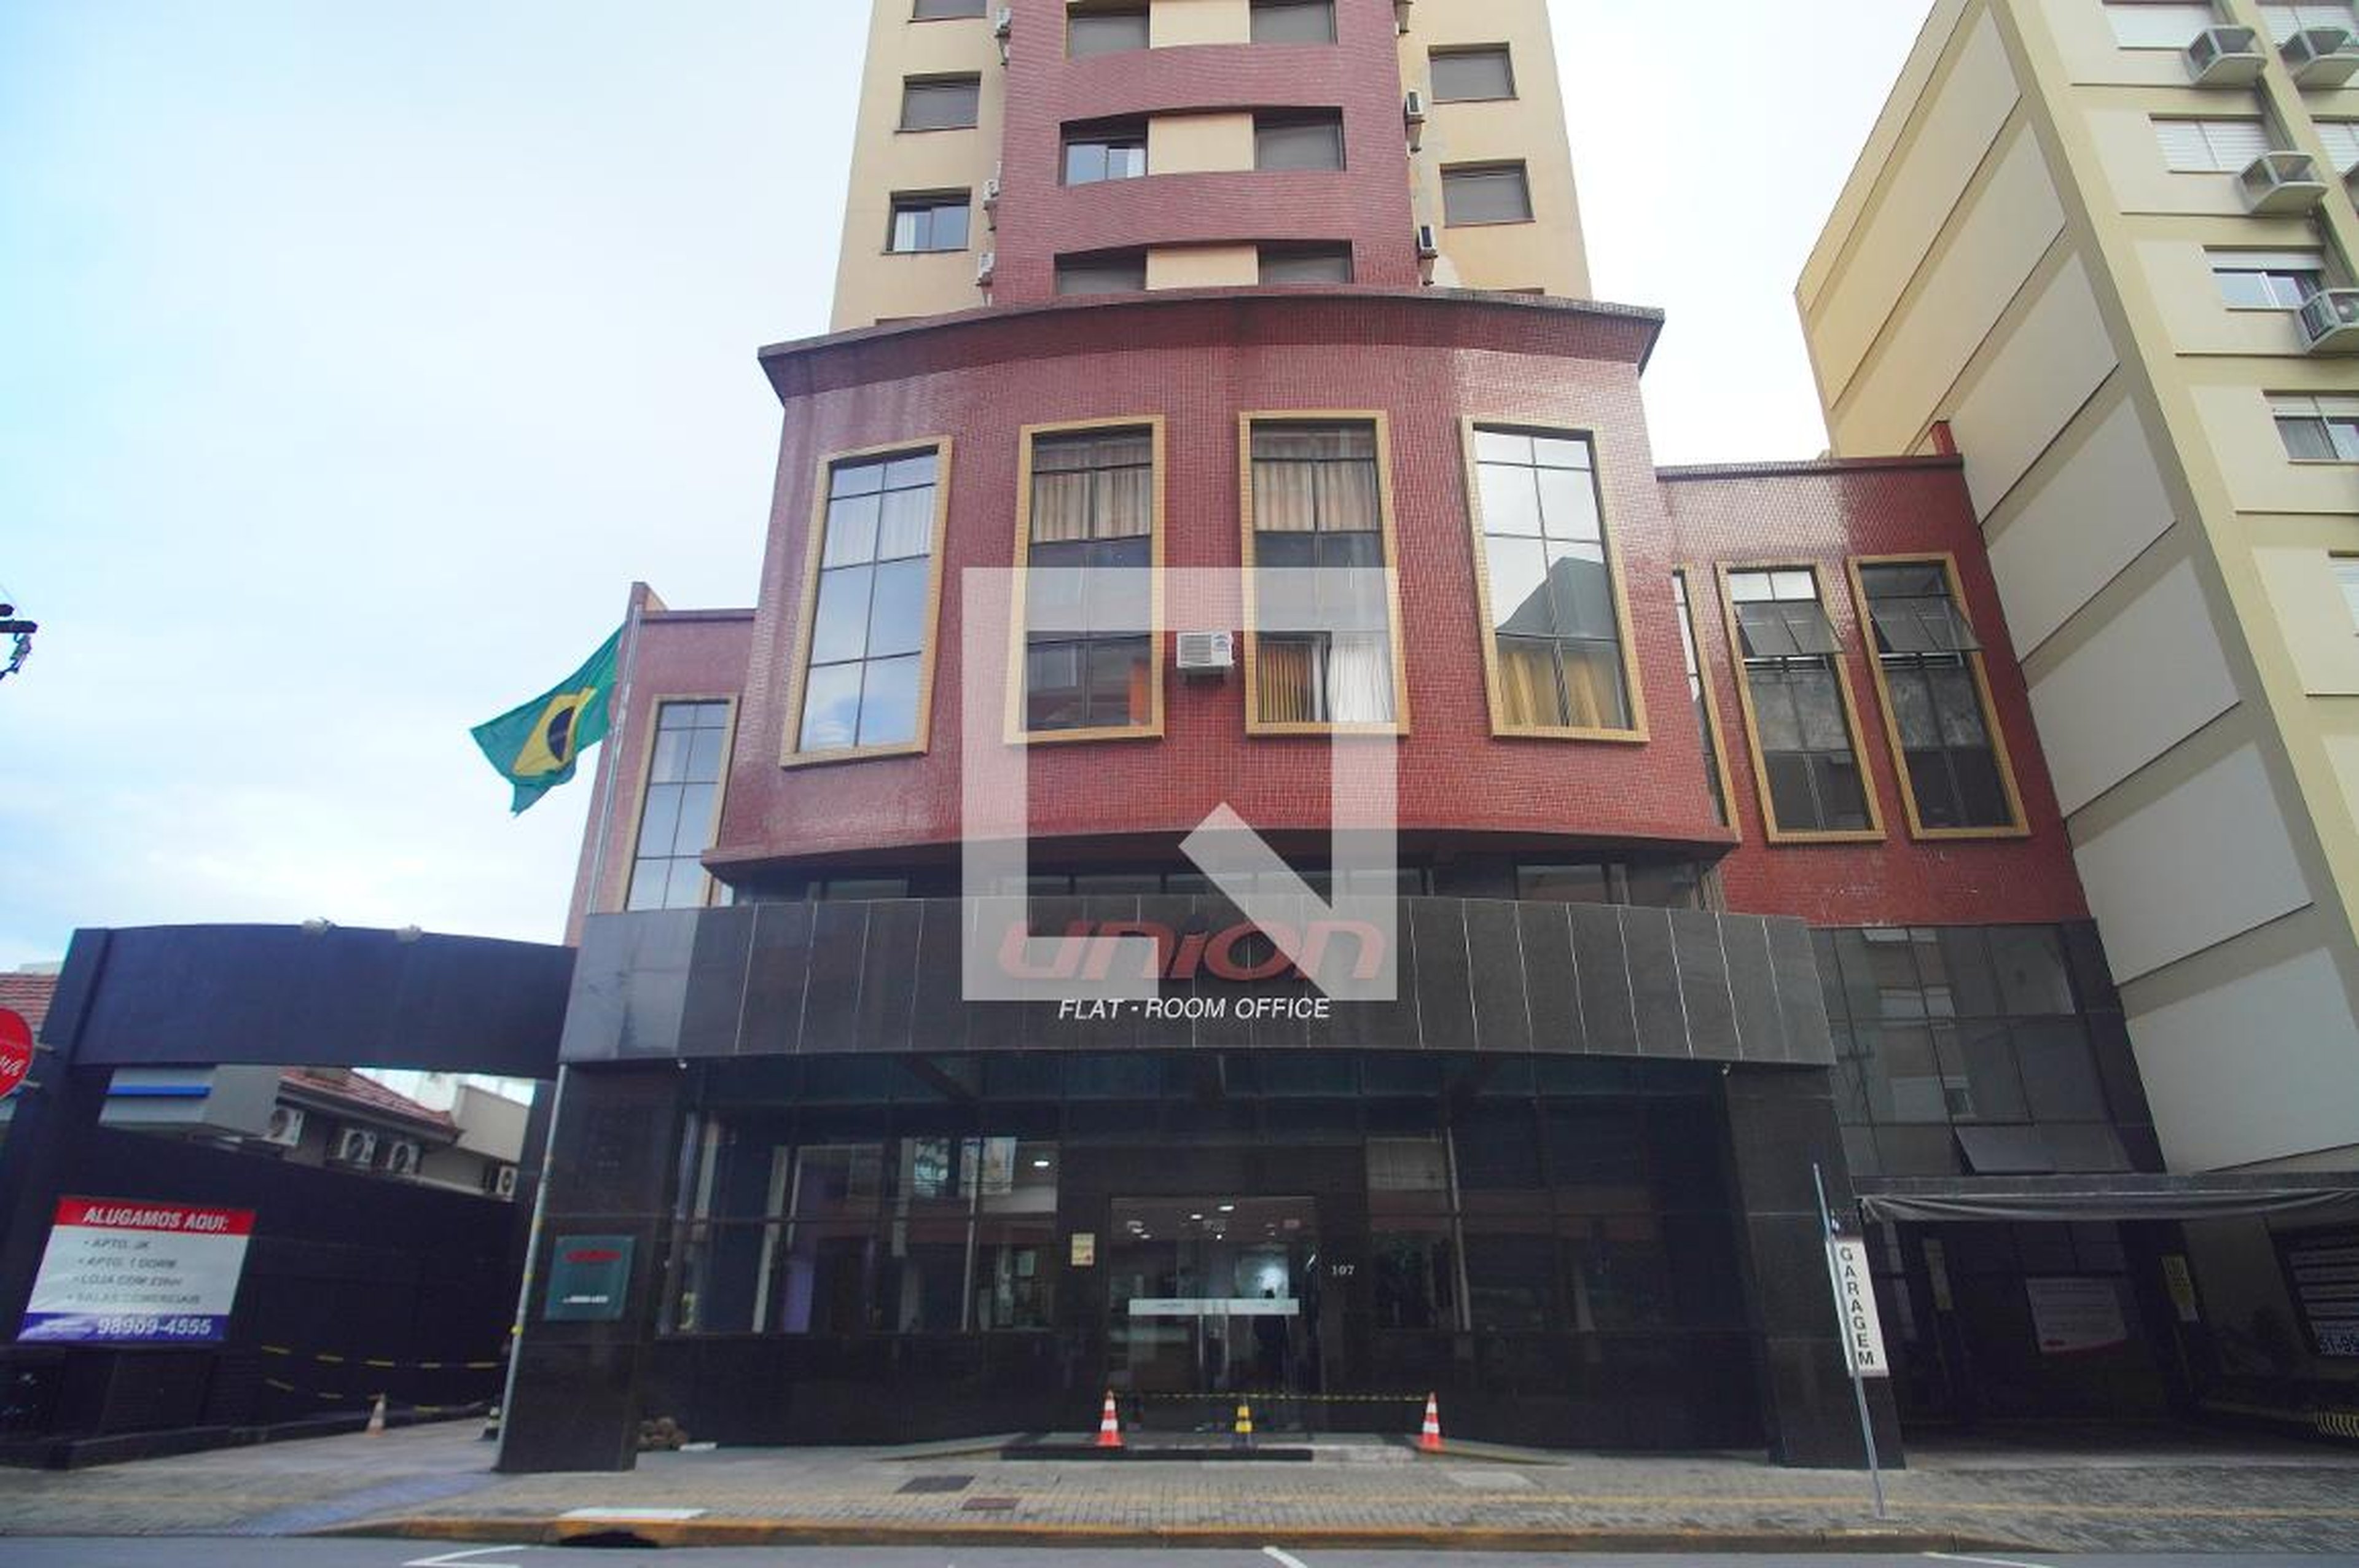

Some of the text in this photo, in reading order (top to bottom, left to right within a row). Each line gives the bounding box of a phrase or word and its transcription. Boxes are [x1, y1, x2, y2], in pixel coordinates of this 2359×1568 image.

[1058, 998, 1124, 1020] FLAT
[1144, 997, 1226, 1018] ROOM
[1235, 997, 1331, 1018] OFFICE
[82, 1206, 229, 1231] ALUGAMOS AQUI:
[1332, 1265, 1355, 1276] 107
[1839, 1247, 1875, 1367] GARAGEM
[97, 1317, 212, 1336] 98909-4555
